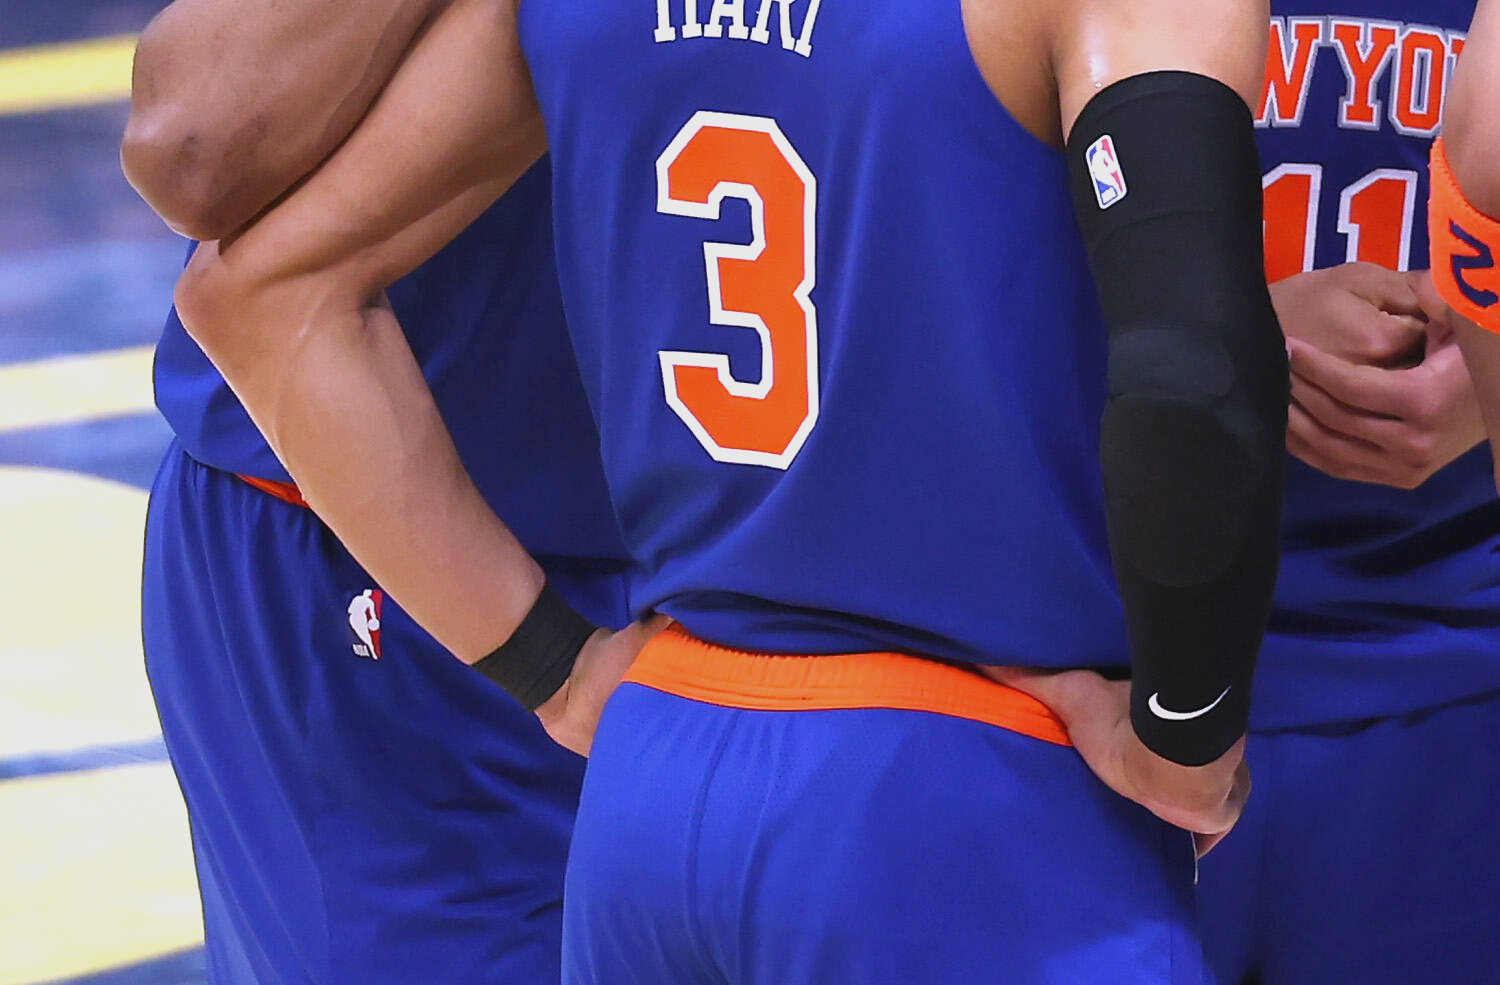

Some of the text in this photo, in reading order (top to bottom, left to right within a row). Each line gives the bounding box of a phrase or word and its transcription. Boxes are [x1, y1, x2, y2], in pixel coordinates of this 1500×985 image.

[1328, 16, 1466, 138] YO
[1263, 163, 1418, 284] 11
[656, 110, 819, 470] 3
